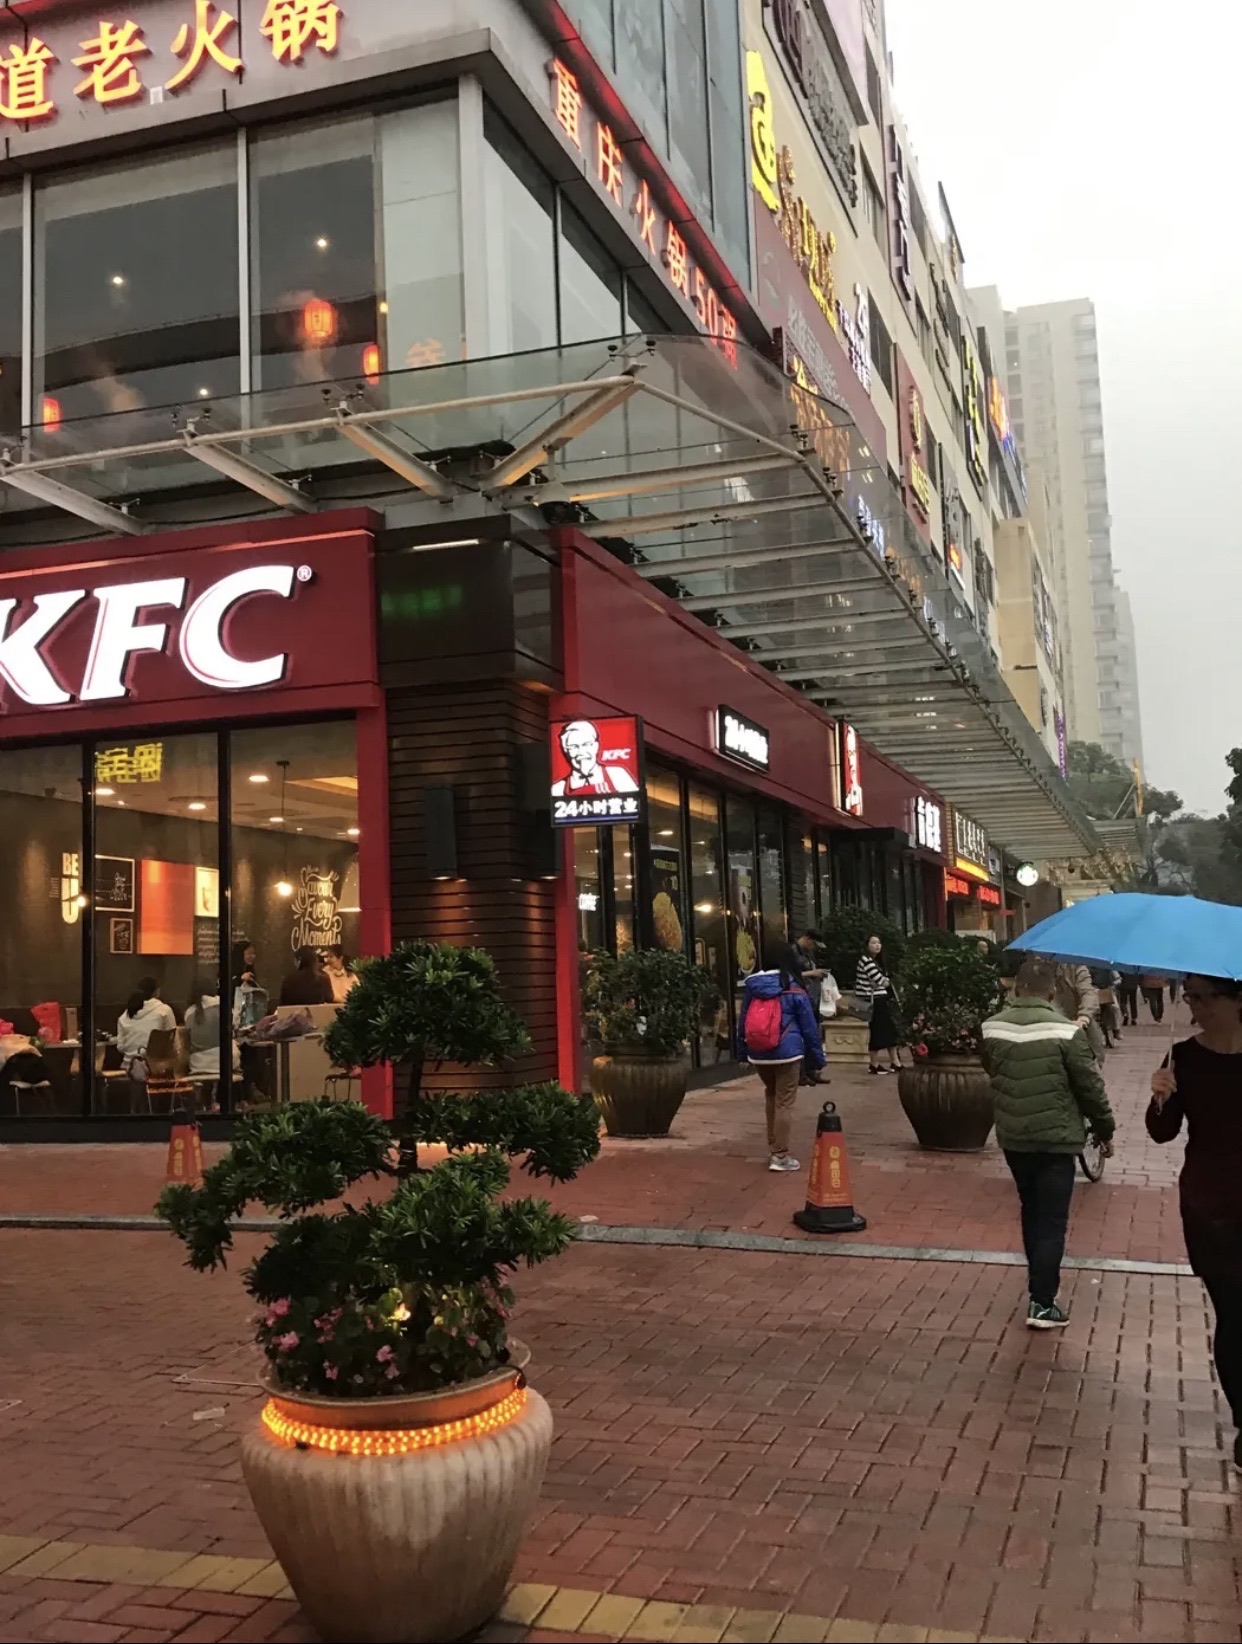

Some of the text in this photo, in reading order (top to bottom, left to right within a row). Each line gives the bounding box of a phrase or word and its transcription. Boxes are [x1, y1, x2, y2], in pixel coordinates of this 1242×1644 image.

[0, 0, 342, 119] 道老火锅
[0, 564, 295, 705] KFC
[601, 748, 631, 761] KFC
[554, 797, 639, 818] 24小时营业
[62, 852, 79, 876] BE
[304, 897, 337, 930] Every
[291, 916, 343, 952] Moment
